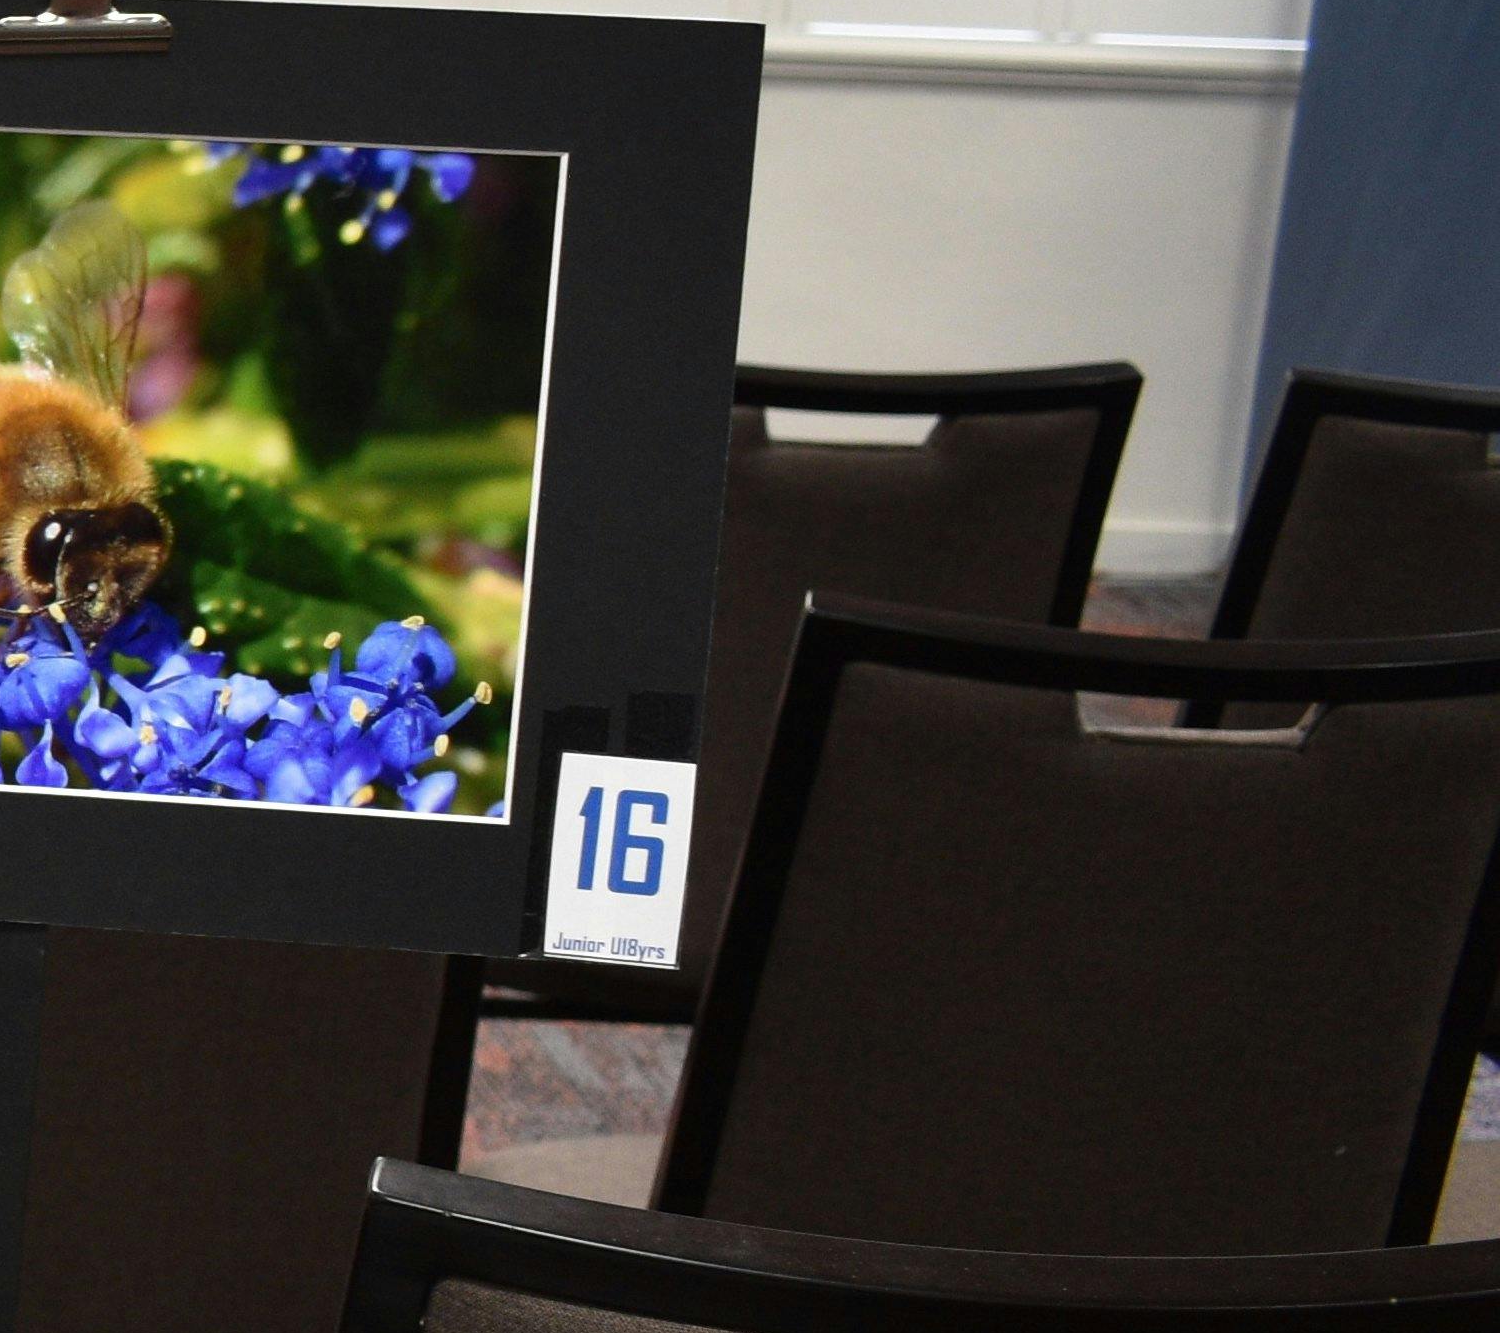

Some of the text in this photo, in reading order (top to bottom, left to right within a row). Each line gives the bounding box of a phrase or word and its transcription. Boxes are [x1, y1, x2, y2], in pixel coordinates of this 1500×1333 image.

[576, 785, 670, 897] 16
[552, 931, 666, 961] Junior U18yrs
